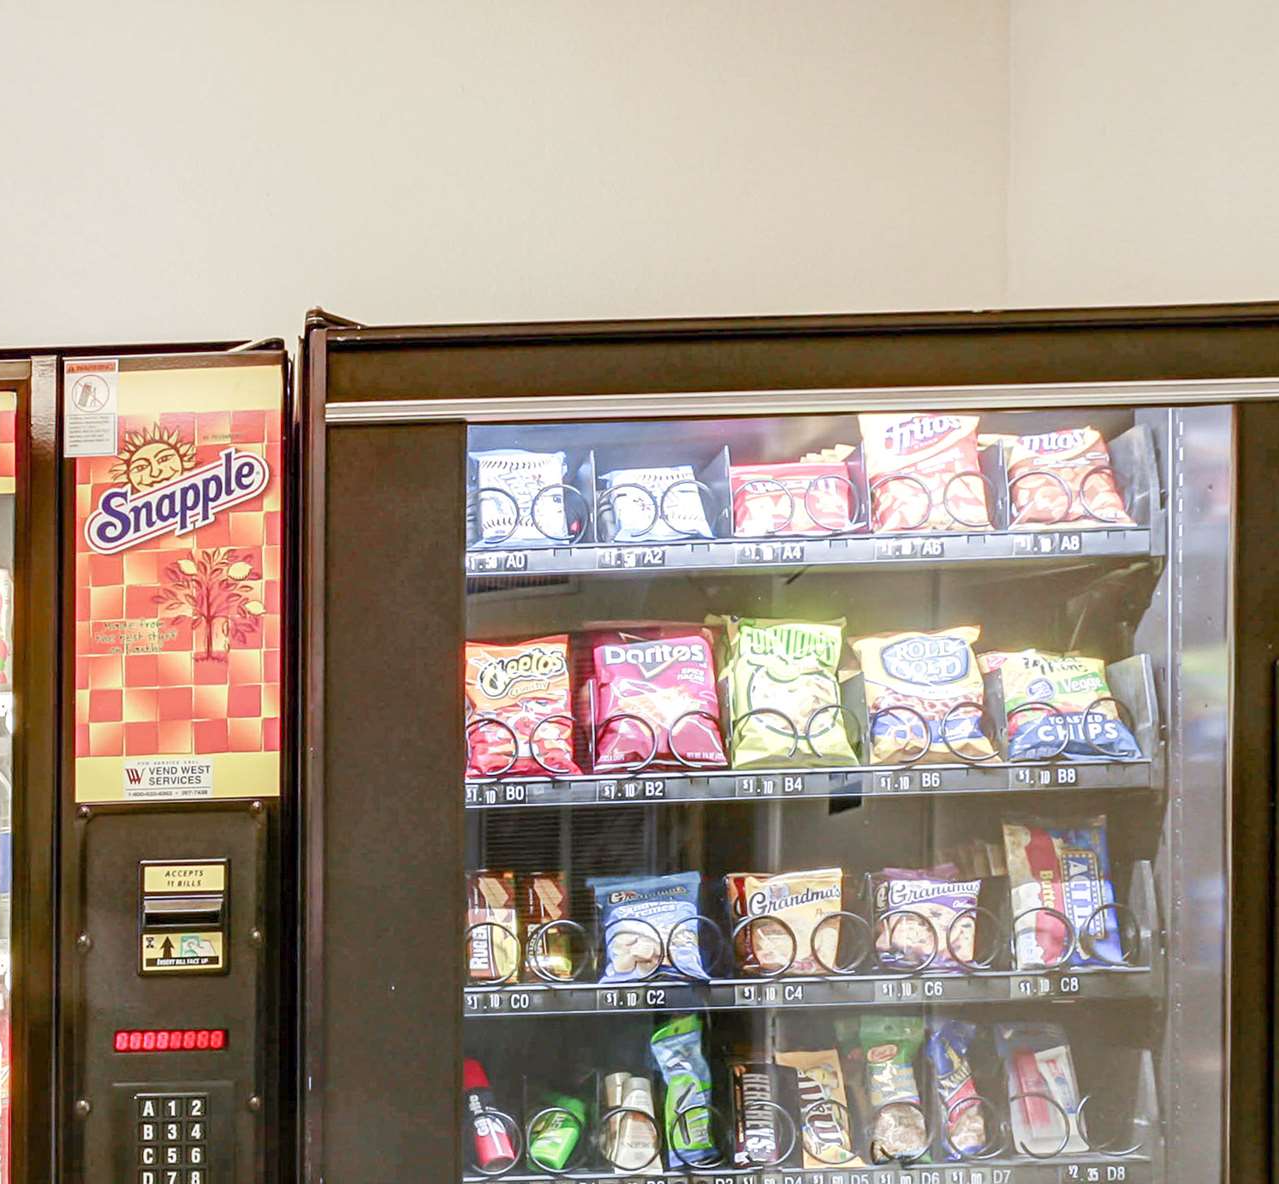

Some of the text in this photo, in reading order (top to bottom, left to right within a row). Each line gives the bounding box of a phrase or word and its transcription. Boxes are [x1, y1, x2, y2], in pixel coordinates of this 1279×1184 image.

[96, 450, 256, 544] Snapple
[1061, 536, 1080, 551] A8
[644, 550, 662, 565] A2
[604, 645, 705, 665] Doritos
[480, 648, 567, 696] Cheetos
[906, 657, 962, 679] GOLD
[1038, 722, 1118, 741] CHIPS
[149, 765, 210, 775] VEND WEST
[1058, 768, 1076, 783] B8
[149, 776, 201, 785] SERVICES
[784, 778, 803, 792] B4
[922, 773, 940, 788] B6
[506, 786, 524, 801] B0
[645, 782, 664, 797] B2
[749, 884, 841, 917] Grandma's
[925, 981, 943, 996] C6
[1061, 977, 1079, 992] C8
[646, 990, 665, 1005] C2
[784, 986, 803, 1000] C4
[510, 994, 529, 1008] C0
[143, 1100, 201, 1116] A 1 2
[144, 1124, 201, 1140] B 3 4
[143, 1148, 201, 1164] C 5 6
[1107, 1167, 1125, 1181] D8
